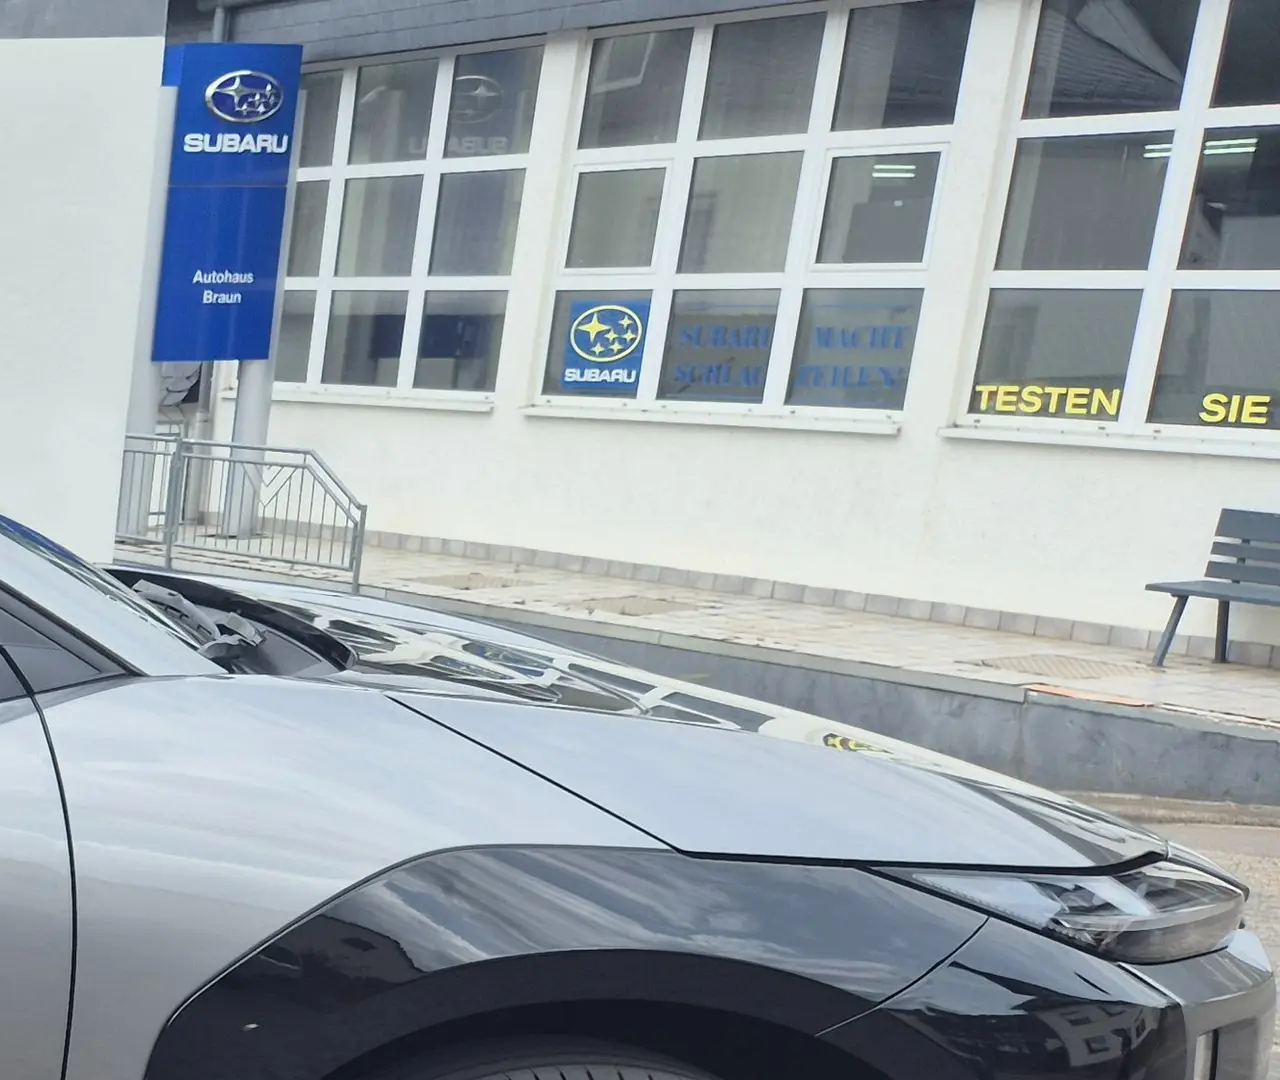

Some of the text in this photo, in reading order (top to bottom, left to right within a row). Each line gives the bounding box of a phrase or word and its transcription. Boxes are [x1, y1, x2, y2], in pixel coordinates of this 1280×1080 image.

[183, 133, 289, 153] SUBARU
[192, 270, 254, 284] Autohaus
[203, 290, 242, 304] Braun
[564, 368, 637, 383] SUBARU
[975, 385, 1271, 424] TESTEN SIE
